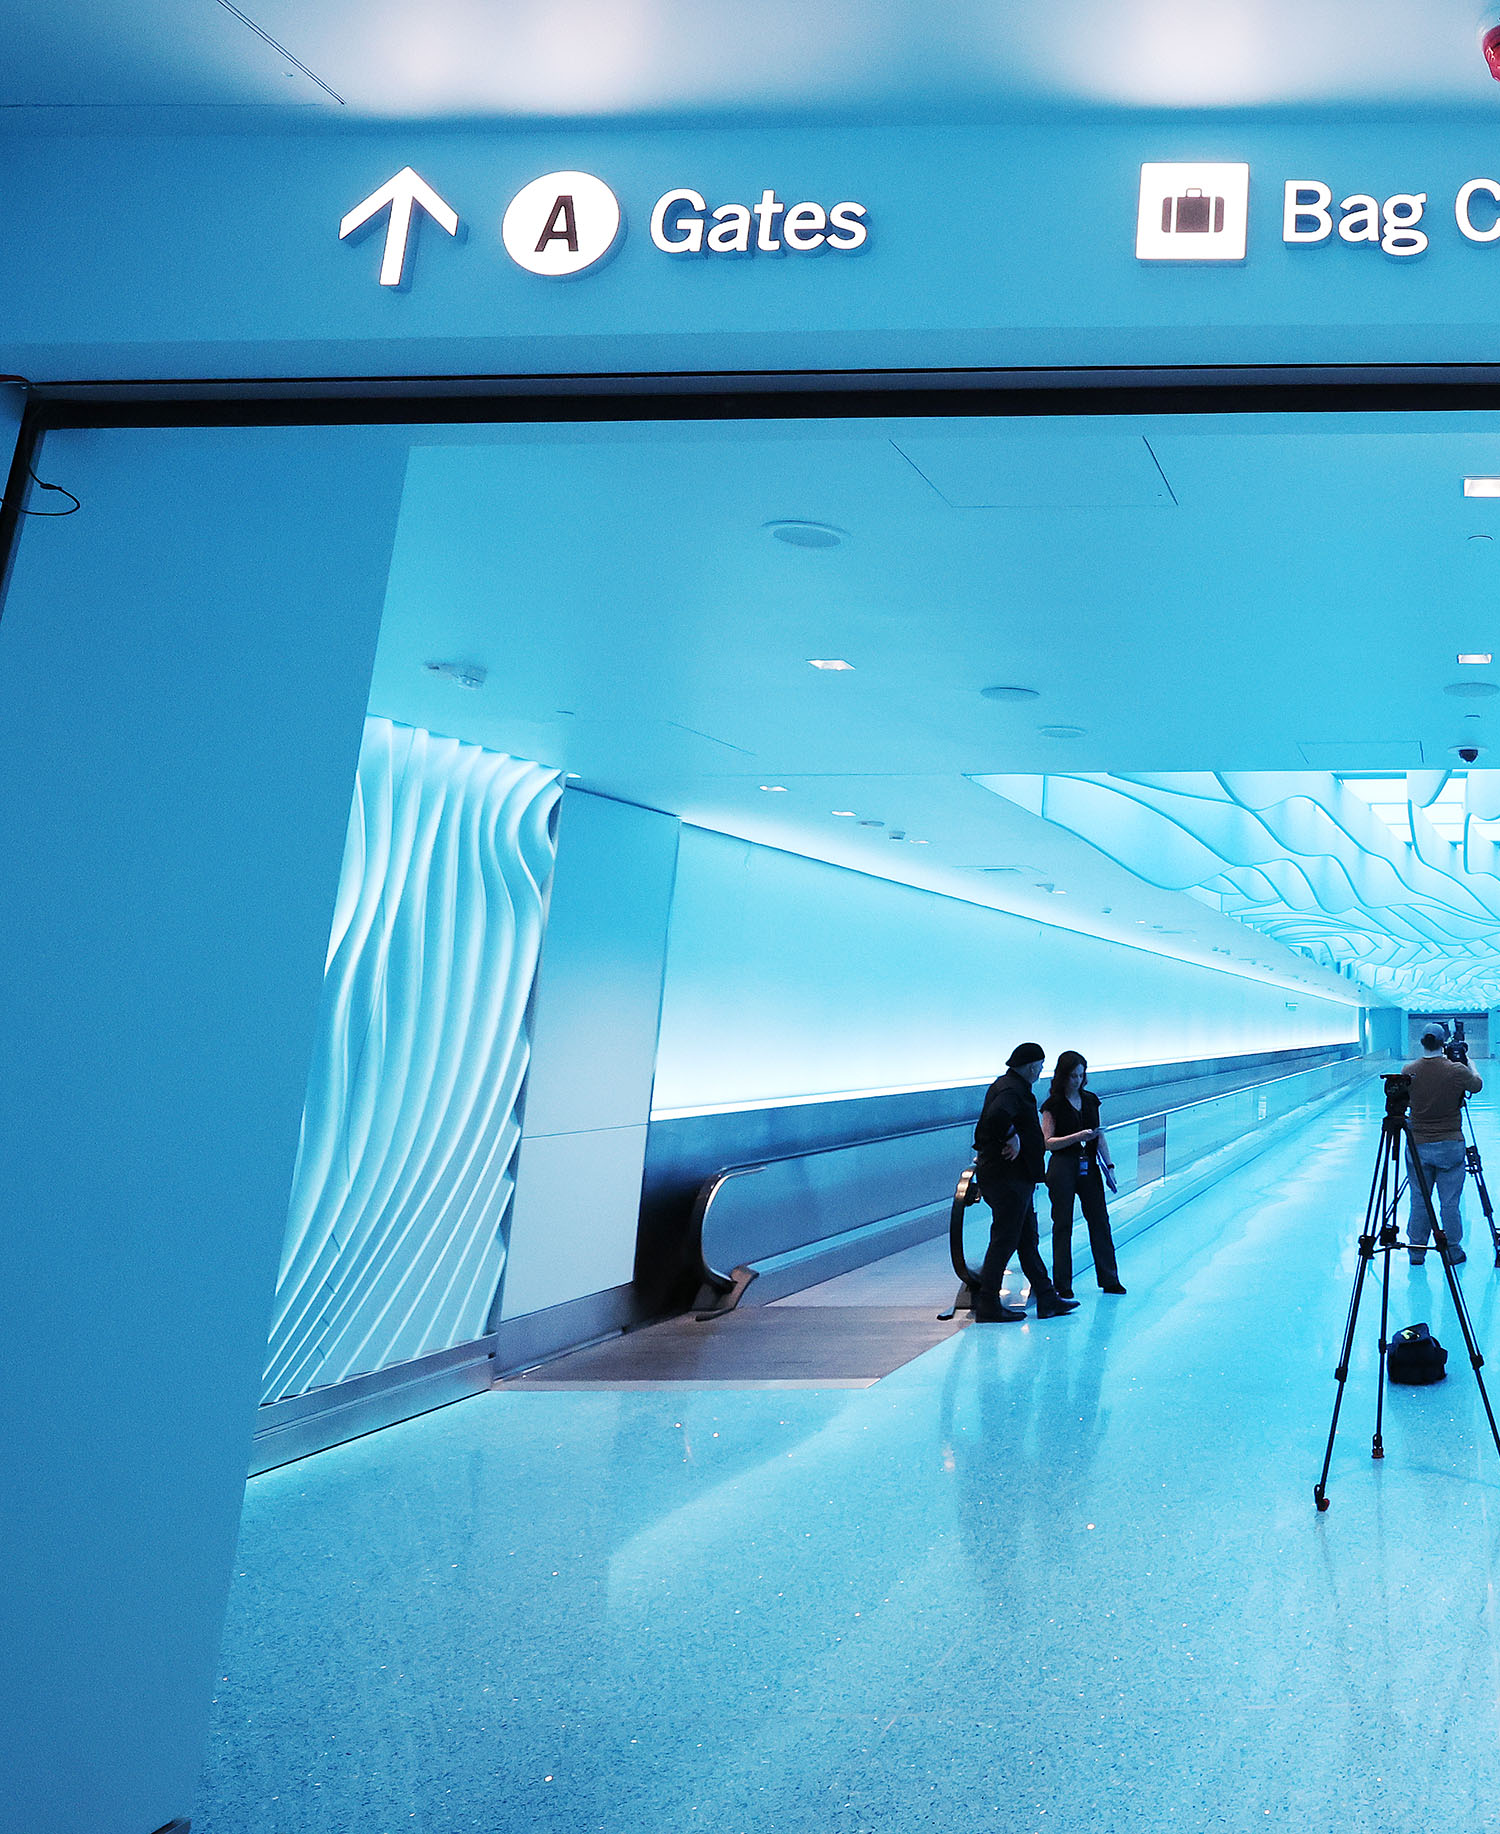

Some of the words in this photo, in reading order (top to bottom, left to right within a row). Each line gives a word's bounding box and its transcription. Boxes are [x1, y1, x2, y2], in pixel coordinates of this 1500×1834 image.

[534, 194, 579, 253] A
[649, 187, 868, 254] Gates
[1281, 178, 1429, 257] Bag
